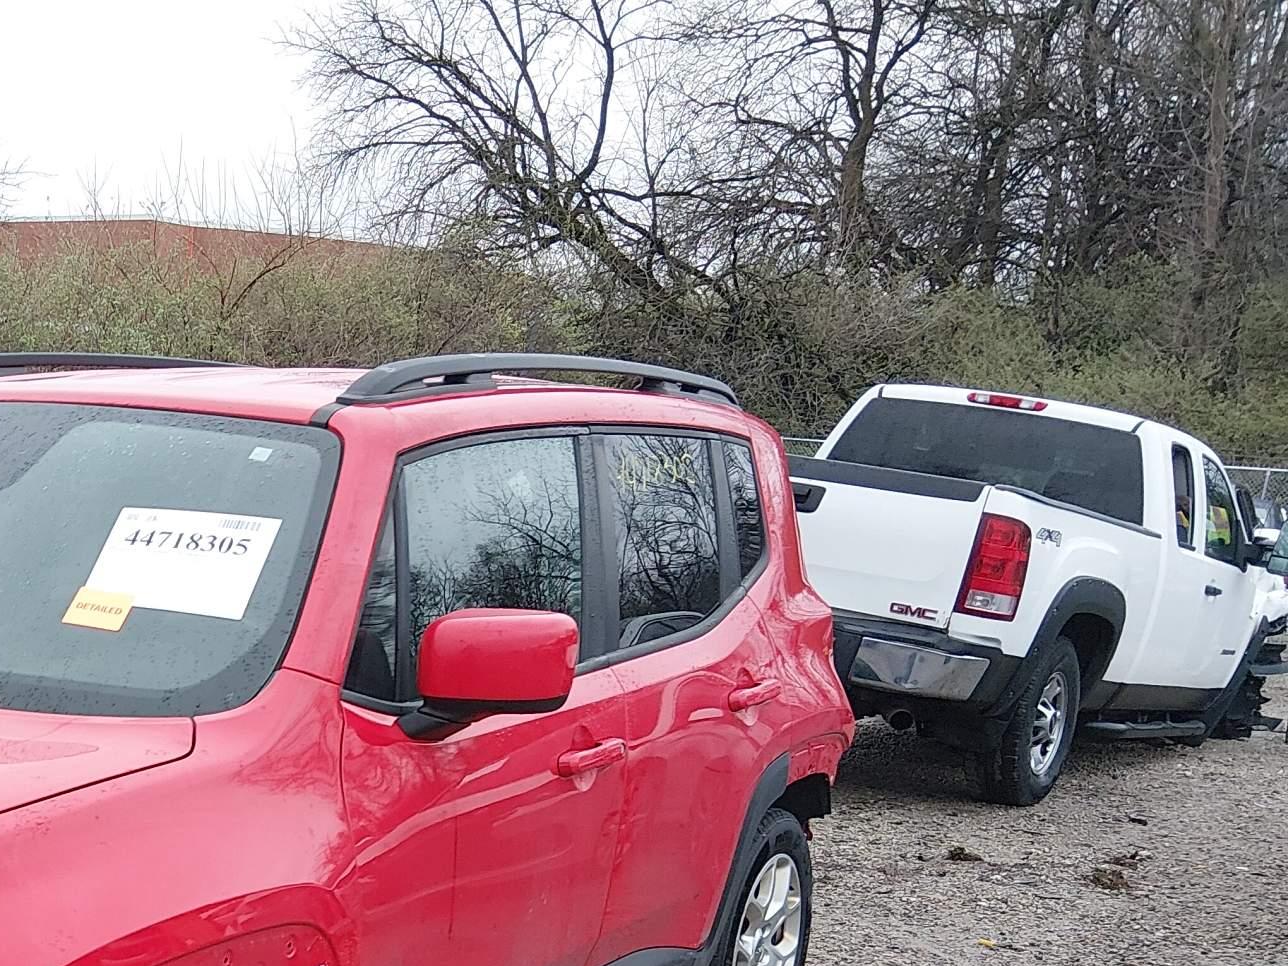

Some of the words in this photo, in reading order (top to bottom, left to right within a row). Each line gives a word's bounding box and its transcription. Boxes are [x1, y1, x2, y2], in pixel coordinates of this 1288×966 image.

[124, 529, 252, 556] 44718305
[75, 602, 123, 615] DETAILED
[890, 602, 938, 621] GMC
